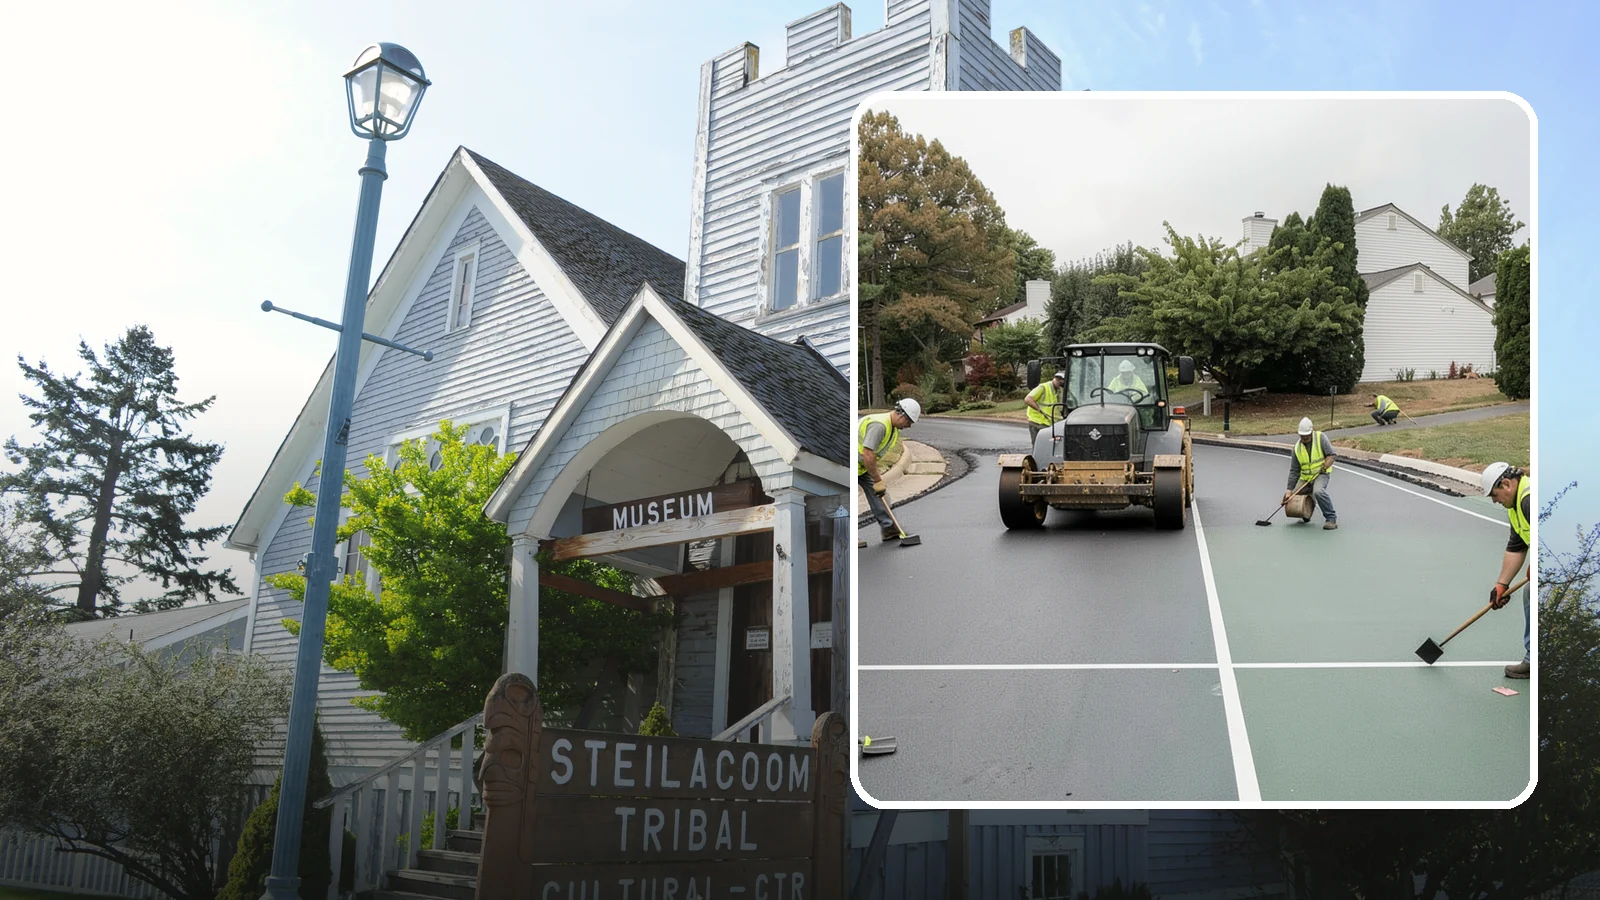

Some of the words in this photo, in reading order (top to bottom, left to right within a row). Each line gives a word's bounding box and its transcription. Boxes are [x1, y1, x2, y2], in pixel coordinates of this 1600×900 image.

[613, 491, 714, 531] MUSEUM
[550, 738, 810, 793] STEILACOOM
[615, 807, 758, 852] TRIBAL
